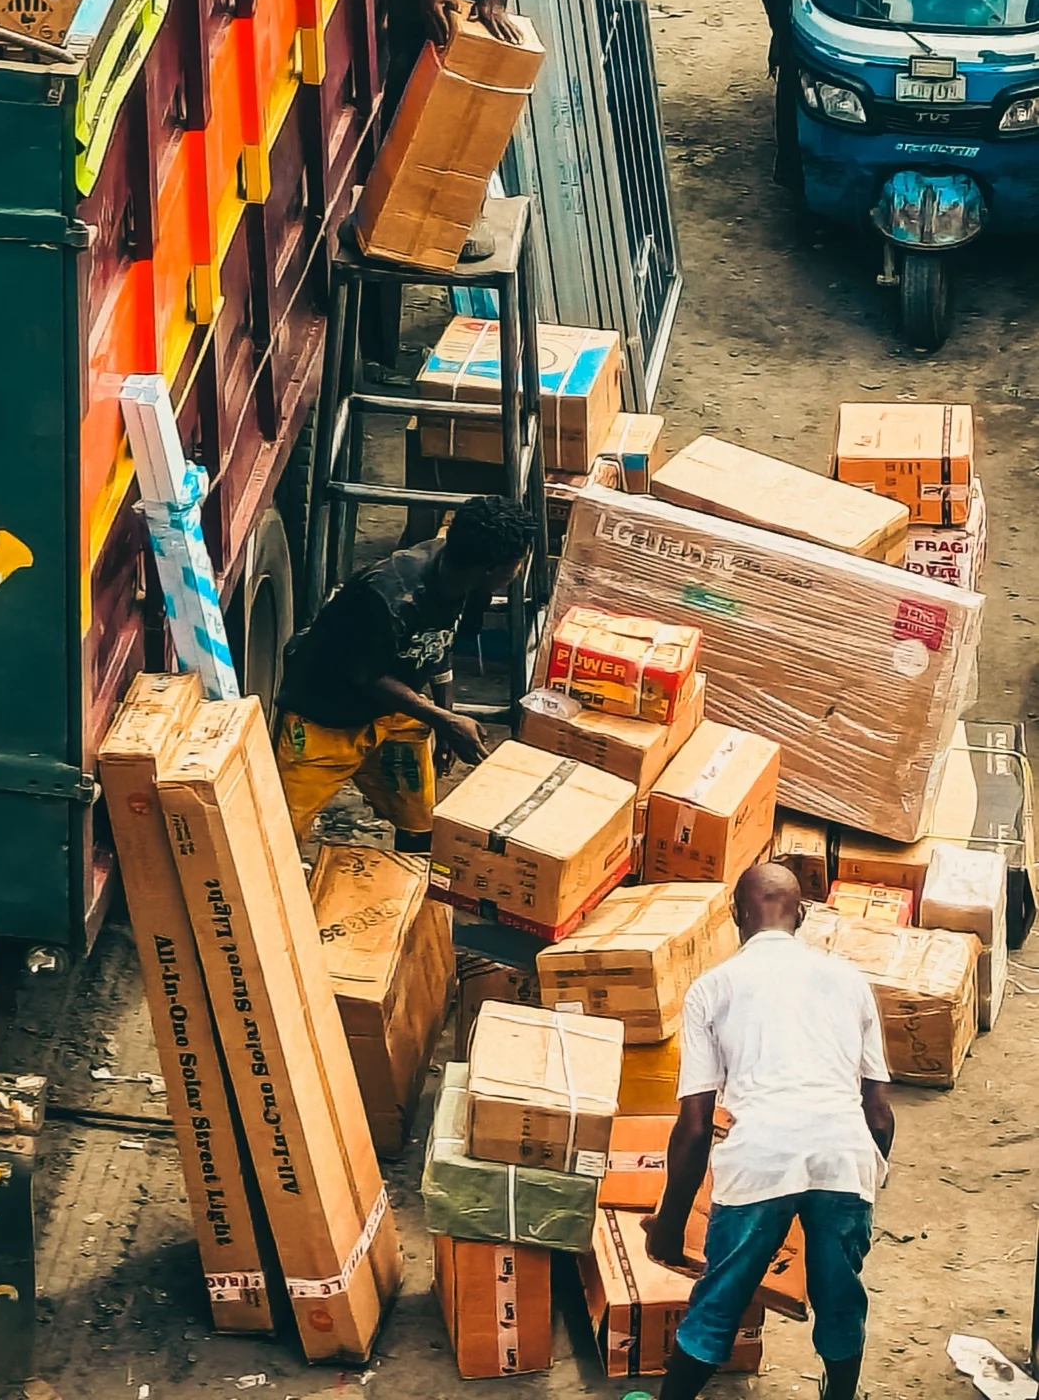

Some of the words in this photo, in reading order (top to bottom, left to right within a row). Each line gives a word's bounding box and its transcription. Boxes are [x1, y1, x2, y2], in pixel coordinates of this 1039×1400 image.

[219, 944, 252, 1012] Street
[240, 1017, 271, 1076] Solar
[179, 1053, 202, 1112] Solar
[191, 1116, 223, 1184] Street
[205, 1188, 234, 1247] Light
